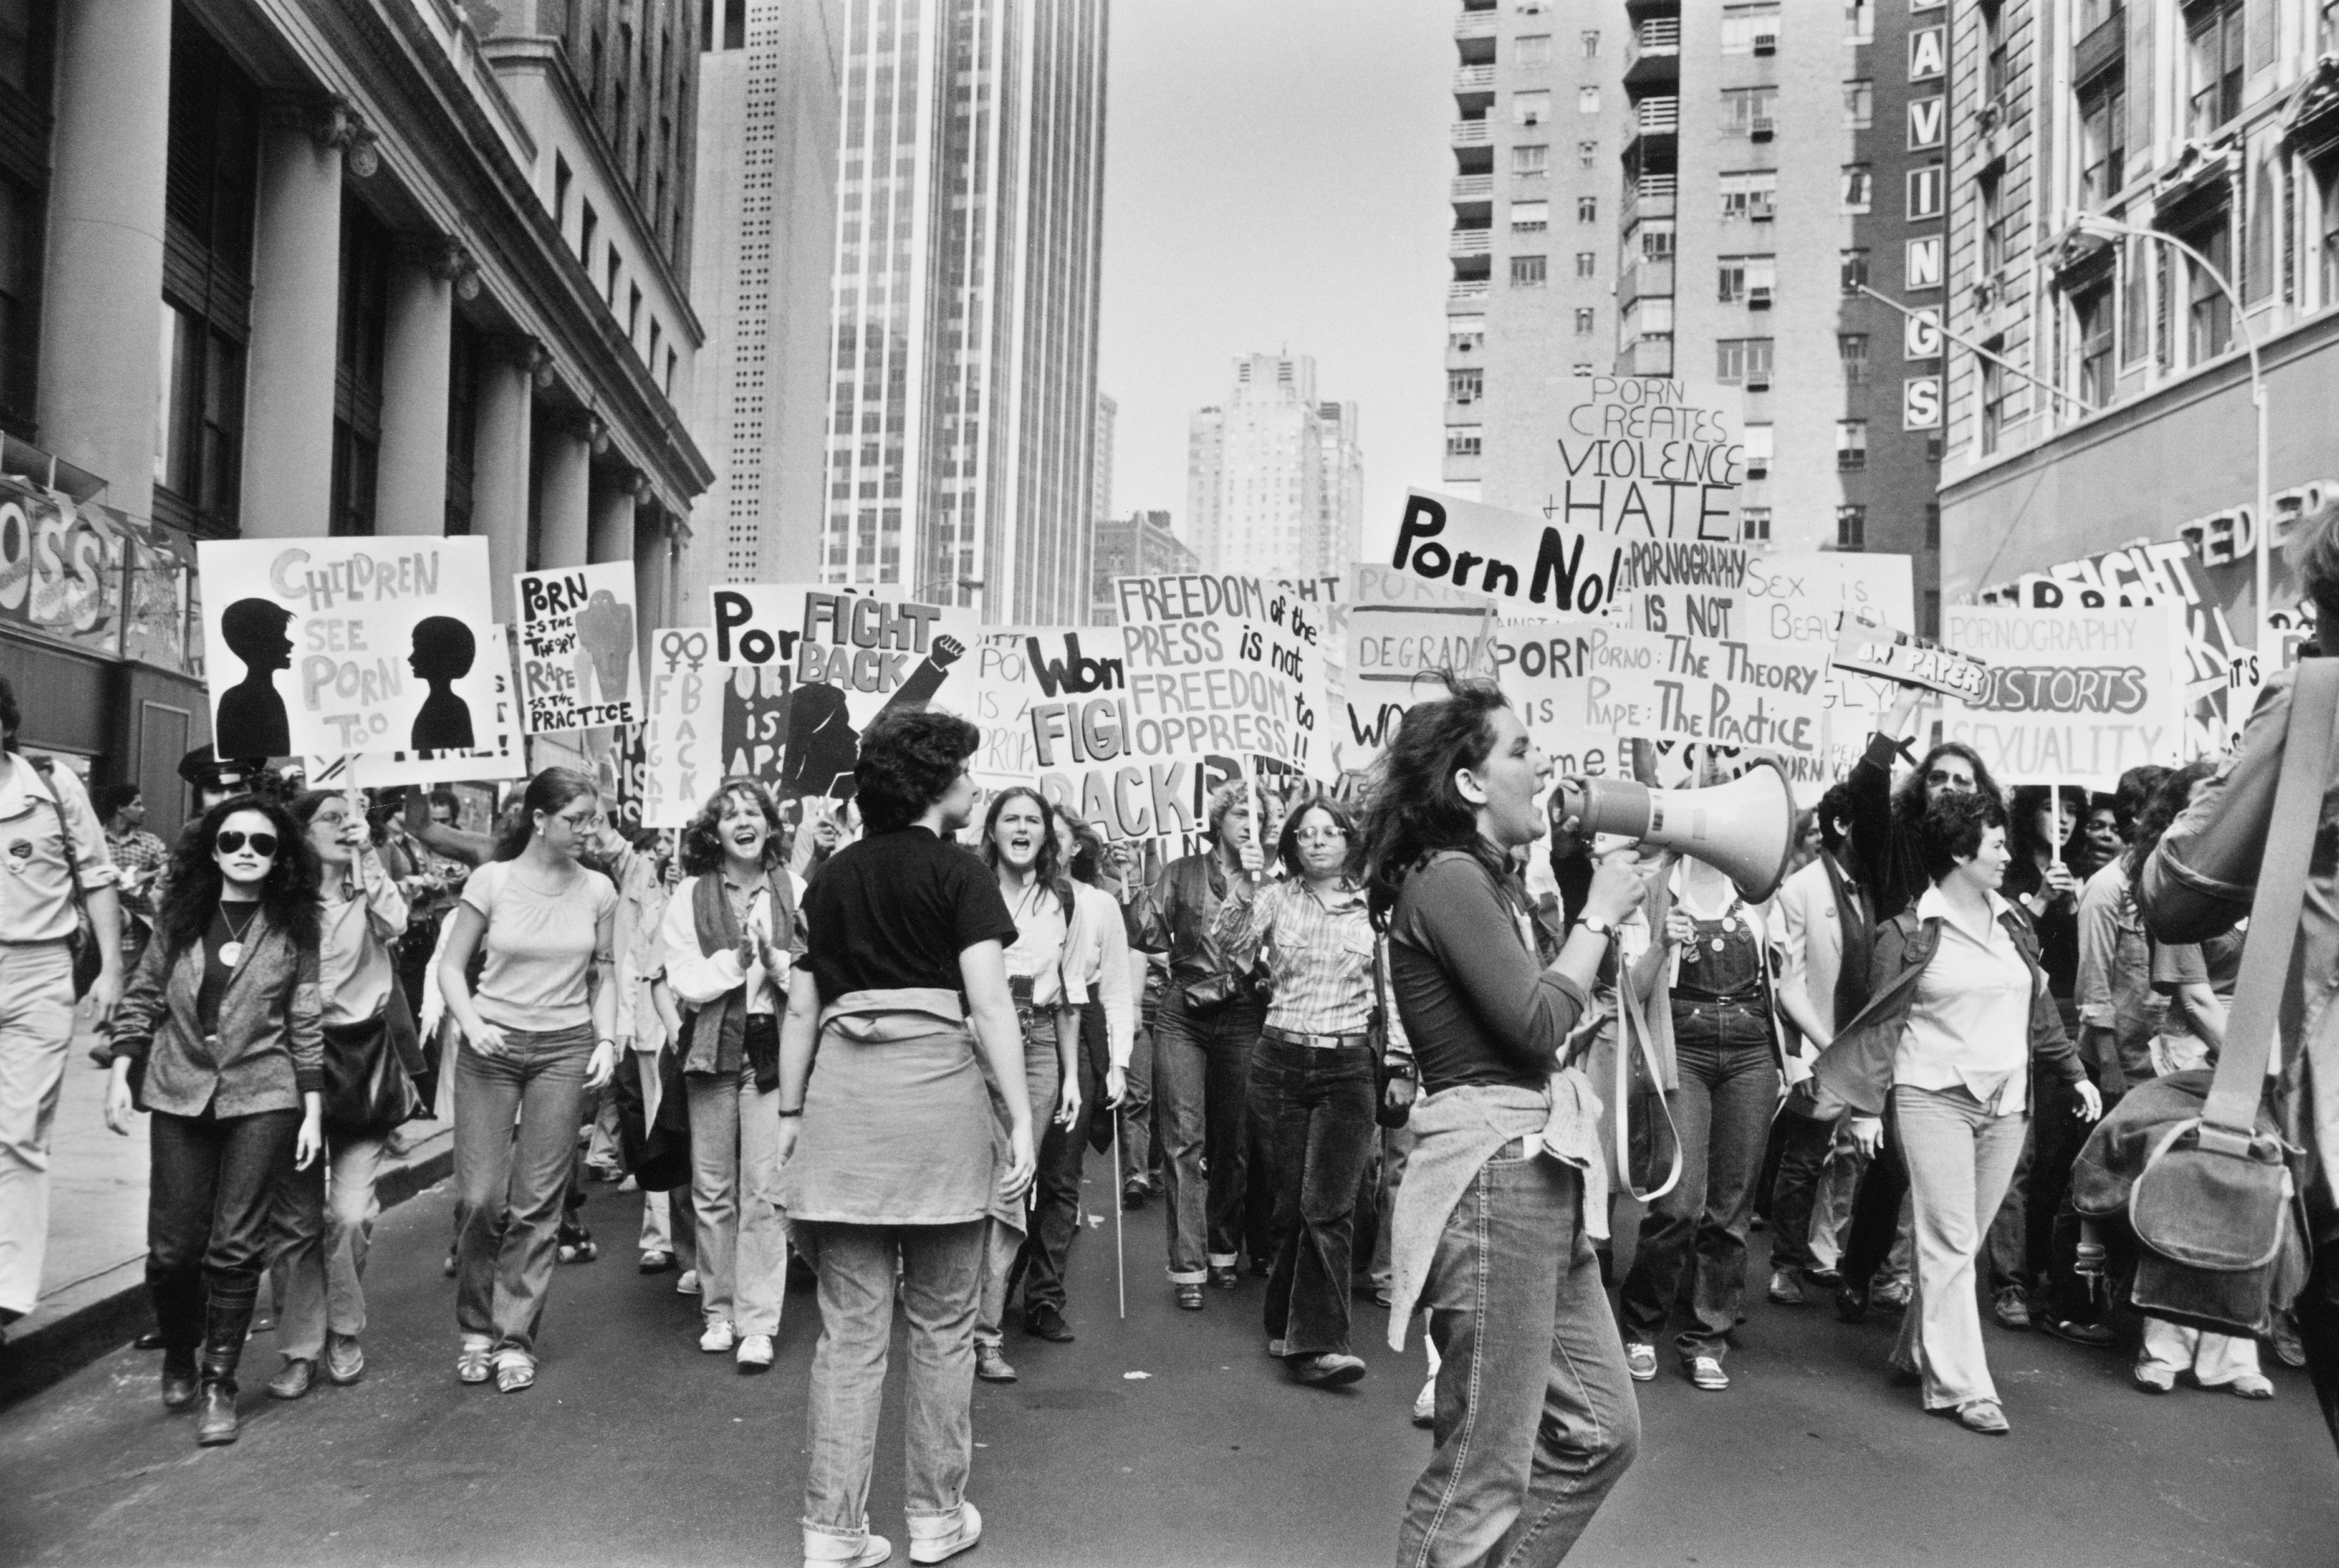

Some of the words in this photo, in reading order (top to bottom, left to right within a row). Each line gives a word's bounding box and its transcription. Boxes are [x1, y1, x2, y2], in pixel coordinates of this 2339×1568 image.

[1907, 0, 1943, 425] AVINGS
[1593, 377, 1684, 404] PORN
[1569, 404, 1727, 443] CREATES
[1558, 439, 1744, 486] VIOLENCE
[1565, 480, 1734, 540] HATE
[1393, 494, 1519, 597] Porn
[1529, 526, 1622, 616] No!
[1631, 541, 1746, 589] PORNOGRAPHY
[270, 548, 439, 611] CHILDREN
[521, 572, 588, 622] PORN
[525, 620, 546, 638] IS
[802, 592, 942, 654] FIGHT
[1118, 575, 1266, 622] FREEDOM
[1270, 595, 1286, 626] of
[1292, 606, 1317, 646] the
[1645, 593, 1667, 633] IS
[1686, 593, 1733, 639] NOT
[304, 618, 368, 652] SEE
[524, 633, 576, 658] THEORY
[1122, 620, 1224, 668] PRESS
[1239, 625, 1263, 661] is
[1271, 642, 1303, 683] not
[1950, 616, 2137, 652] PORNOGRAPHY
[300, 655, 404, 711] PORN
[525, 660, 576, 698] RAPE
[796, 642, 909, 693] BACK
[1906, 651, 1985, 696] PAPER
[528, 697, 546, 710] IS
[532, 702, 633, 732] PRACTICE
[978, 691, 999, 719] IS
[1130, 669, 1289, 722] FREEDOM
[1294, 691, 1314, 731] to
[1136, 714, 1289, 759] OPPRESS
